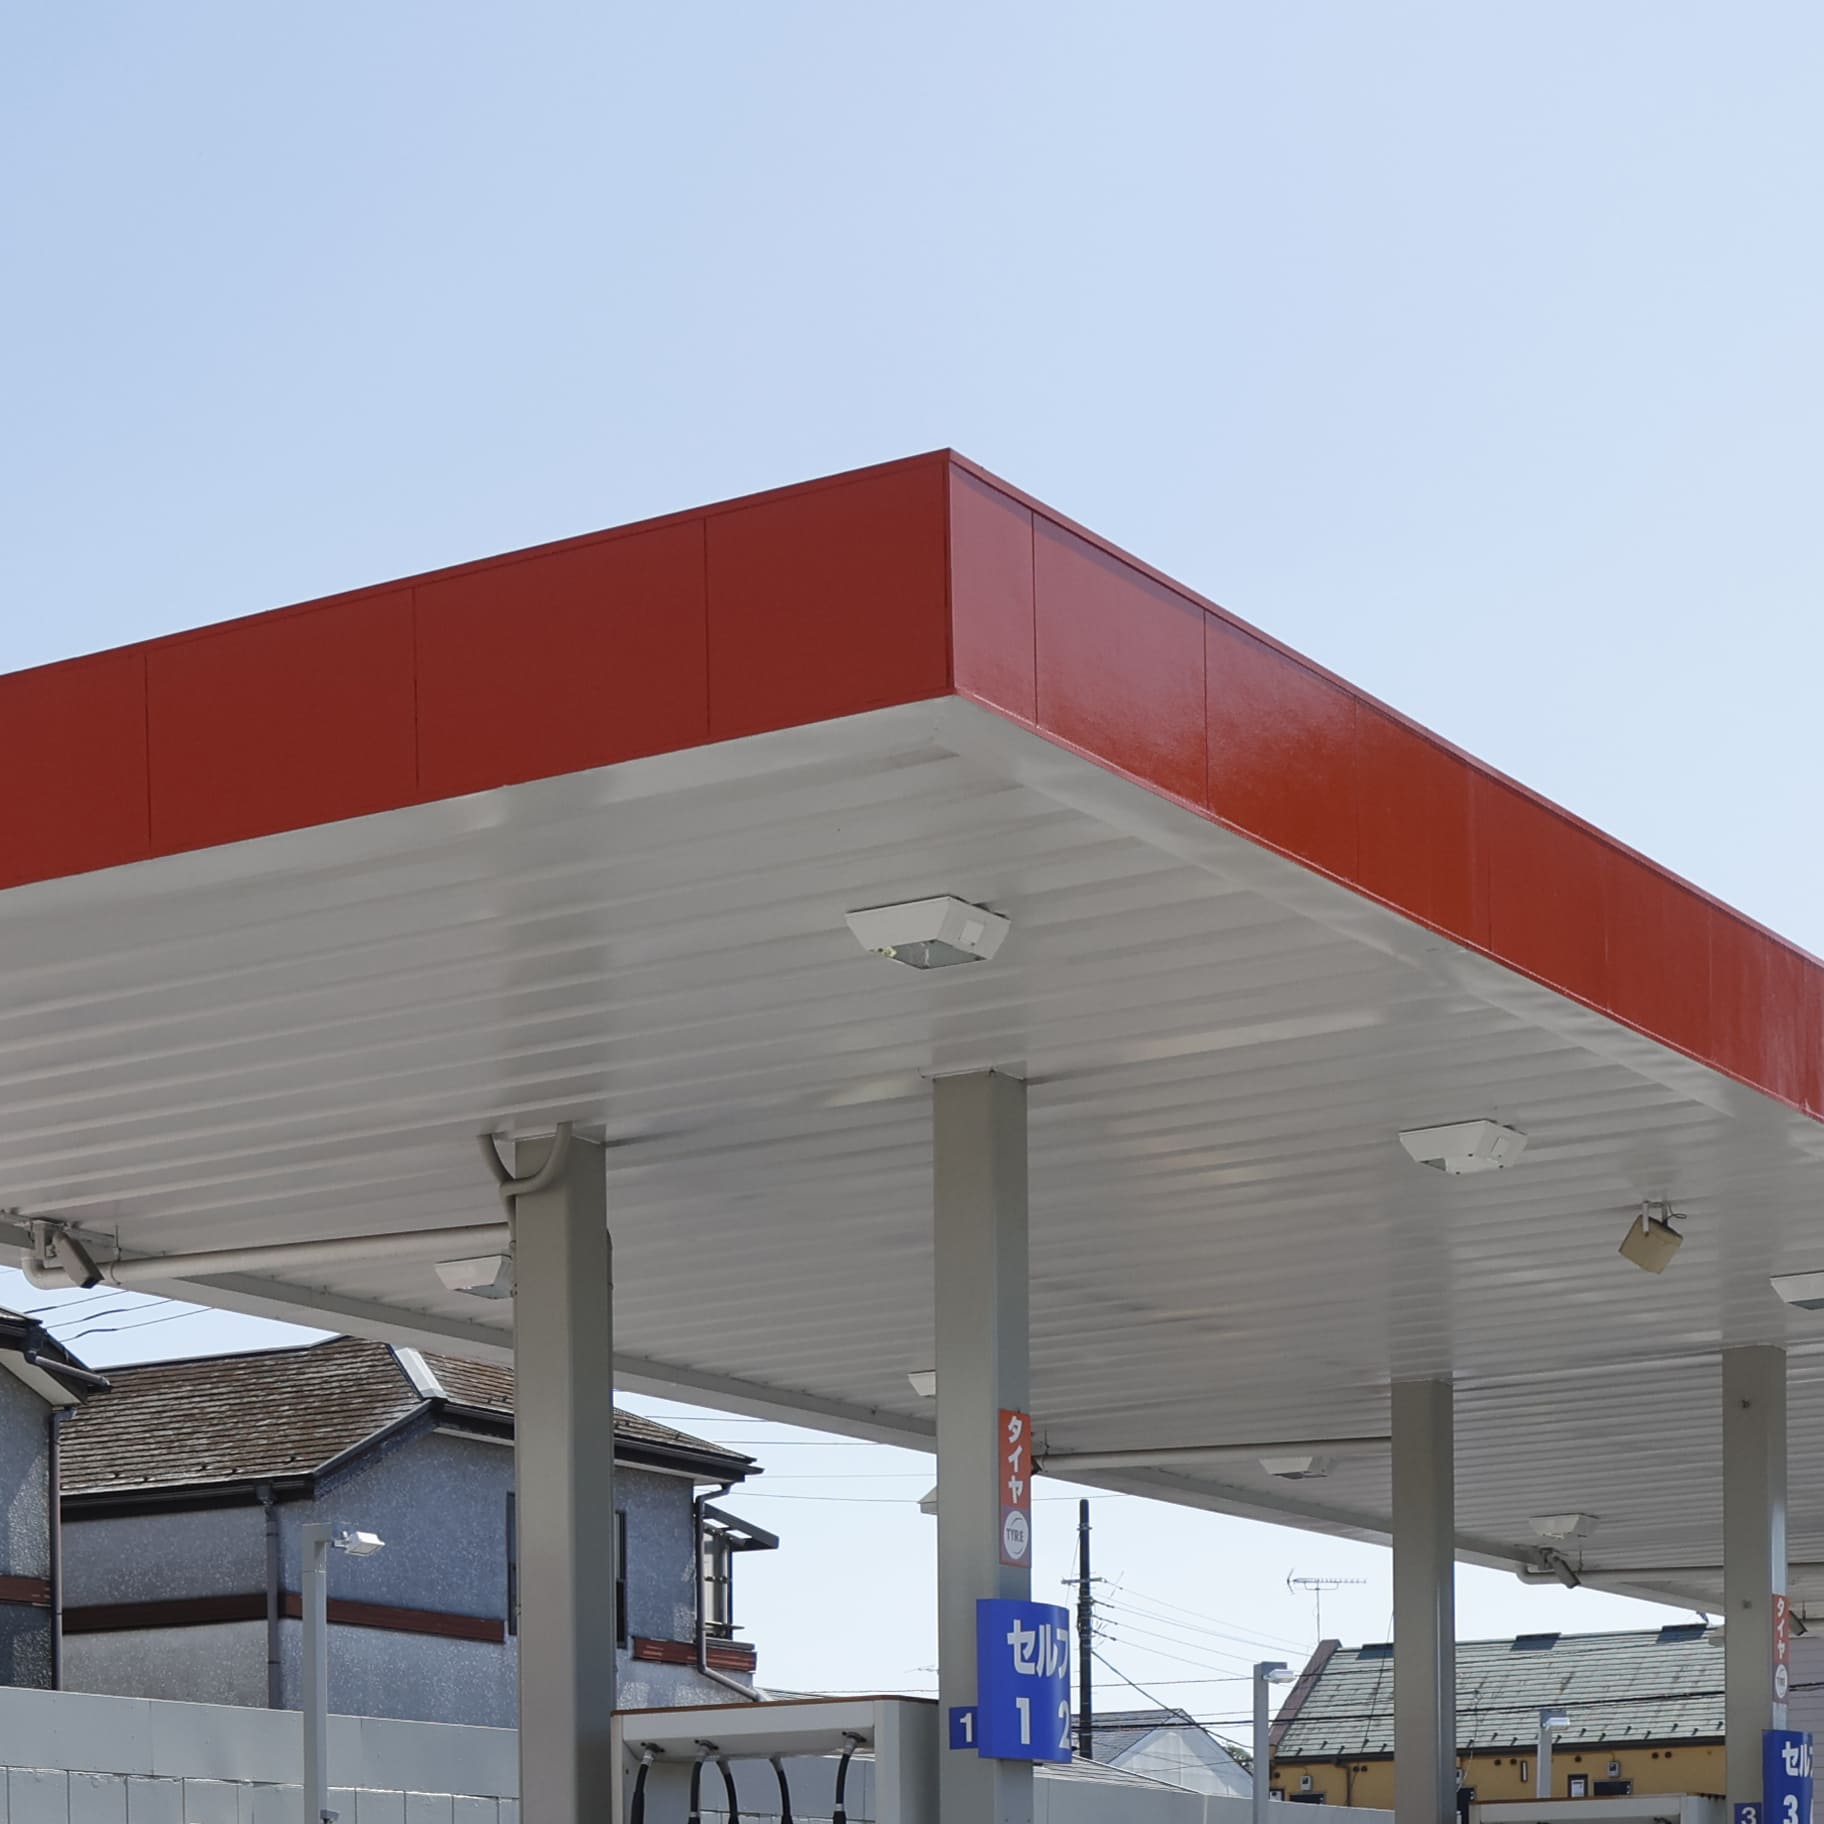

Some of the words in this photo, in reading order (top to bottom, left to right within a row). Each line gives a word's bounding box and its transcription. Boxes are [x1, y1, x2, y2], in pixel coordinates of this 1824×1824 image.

[1008, 1415, 1024, 1504] タイヤ
[1006, 1528, 1025, 1543] TYRE
[960, 1712, 973, 1742] 1
[1016, 1697, 1031, 1744] 1
[1782, 1741, 1814, 1778] セル
